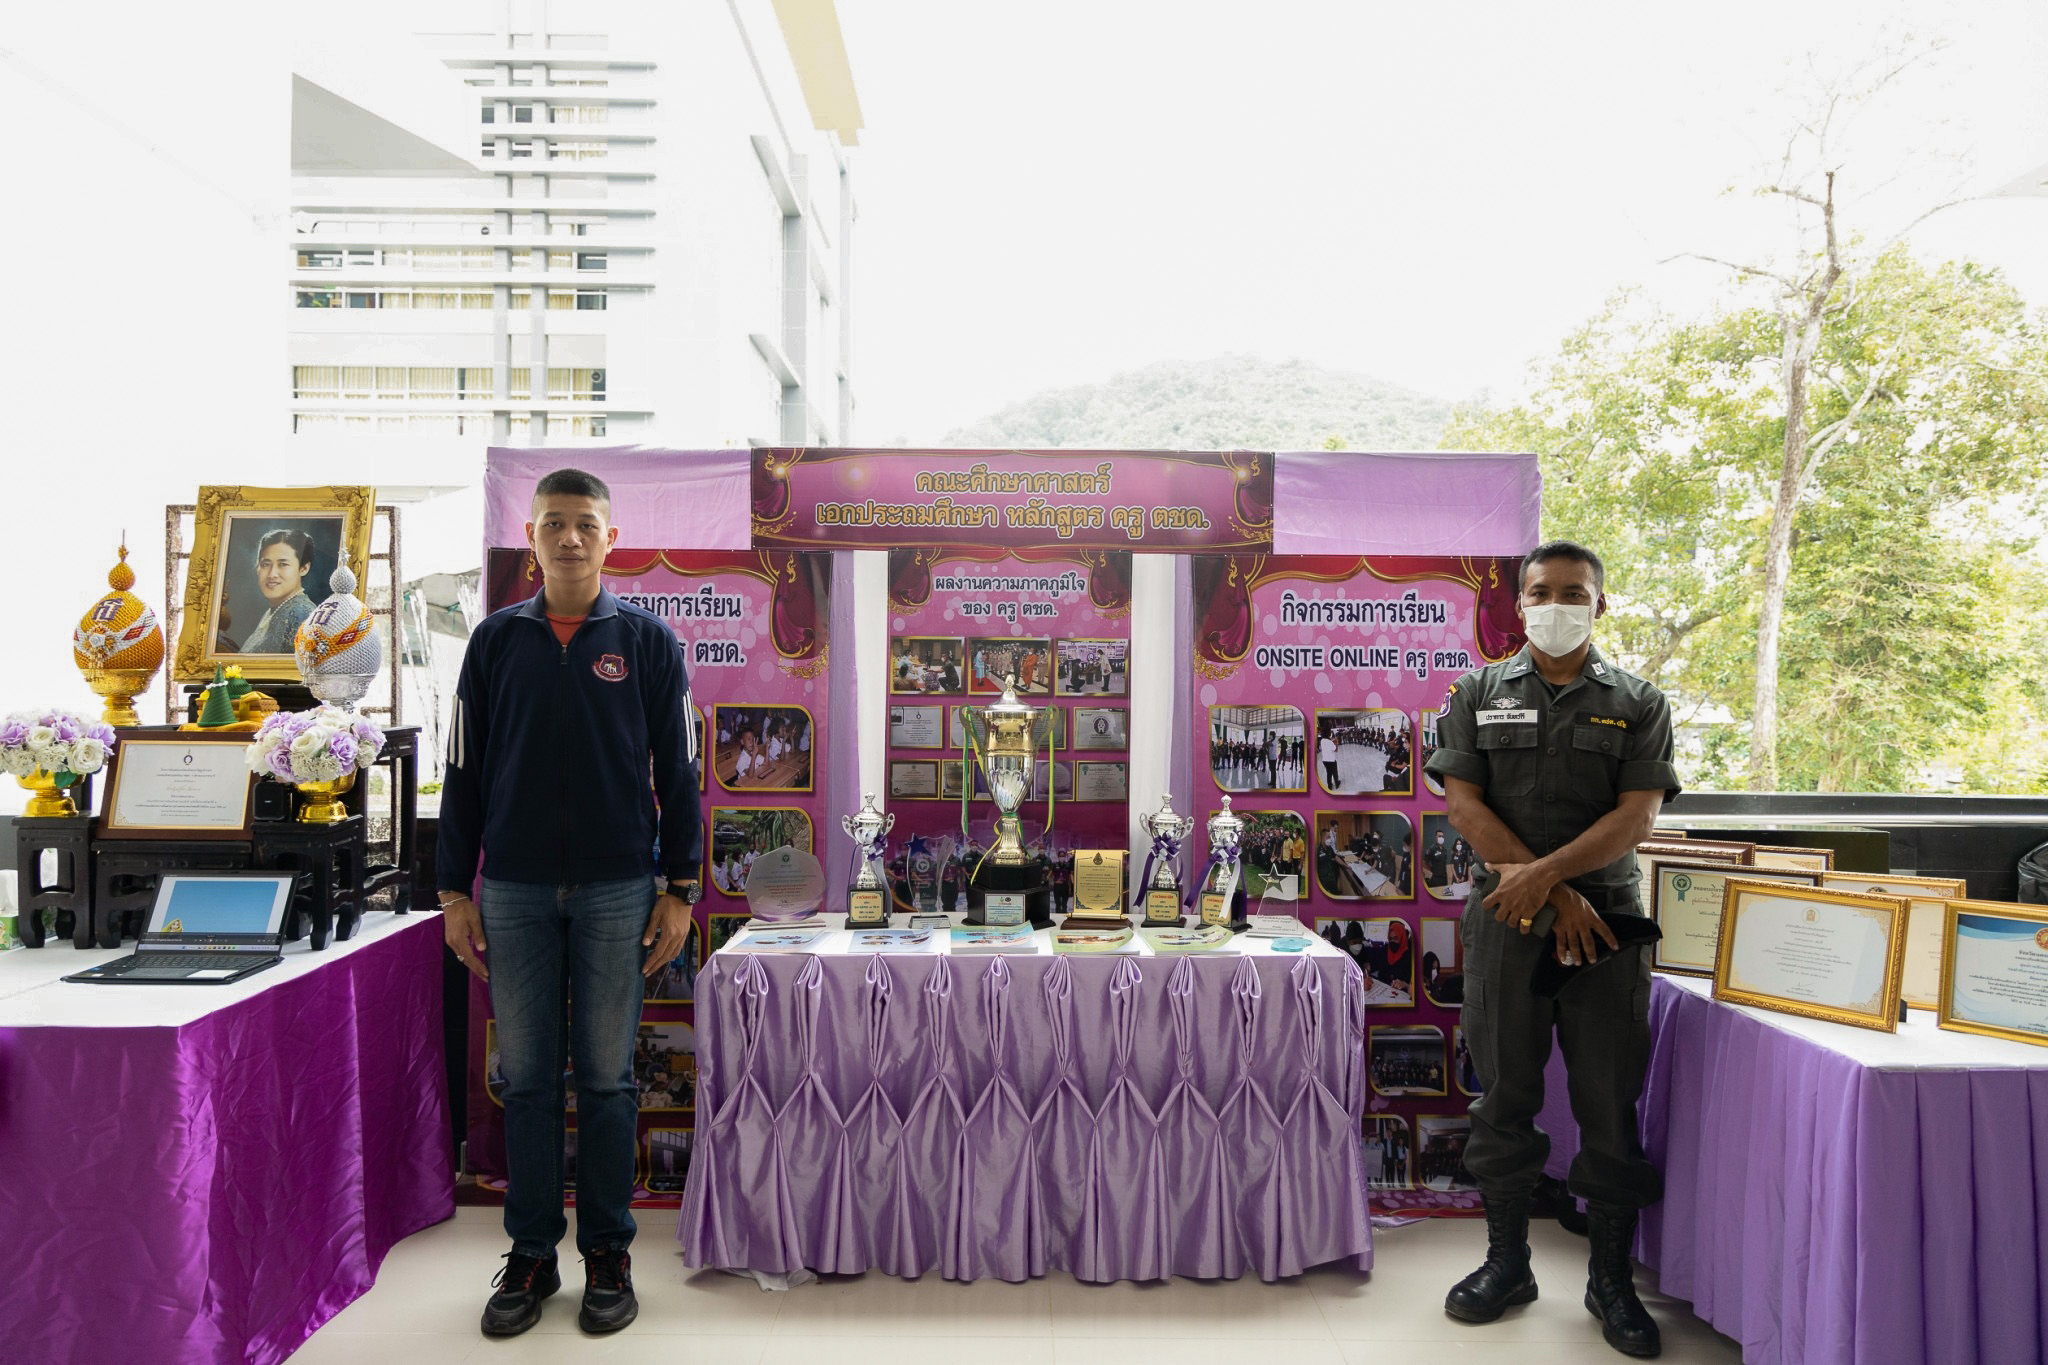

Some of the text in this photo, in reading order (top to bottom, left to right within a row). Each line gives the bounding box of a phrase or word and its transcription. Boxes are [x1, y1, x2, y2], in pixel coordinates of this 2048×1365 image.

[915, 463, 1112, 493] คณะศึกษาศาสตร์
[816, 497, 1211, 538] เอกประถมศึกษา หลักสูตร ครู ตชด.
[935, 571, 1086, 598] ผลงานความภาคภูมิใจ
[962, 602, 1058, 622] ของ ครู ตชด.
[1282, 593, 1446, 623] กิจกรรมการเรียน
[695, 642, 745, 664] ตชด.
[1256, 648, 1474, 678] ONSITE ONLINE ครู ตชด.
